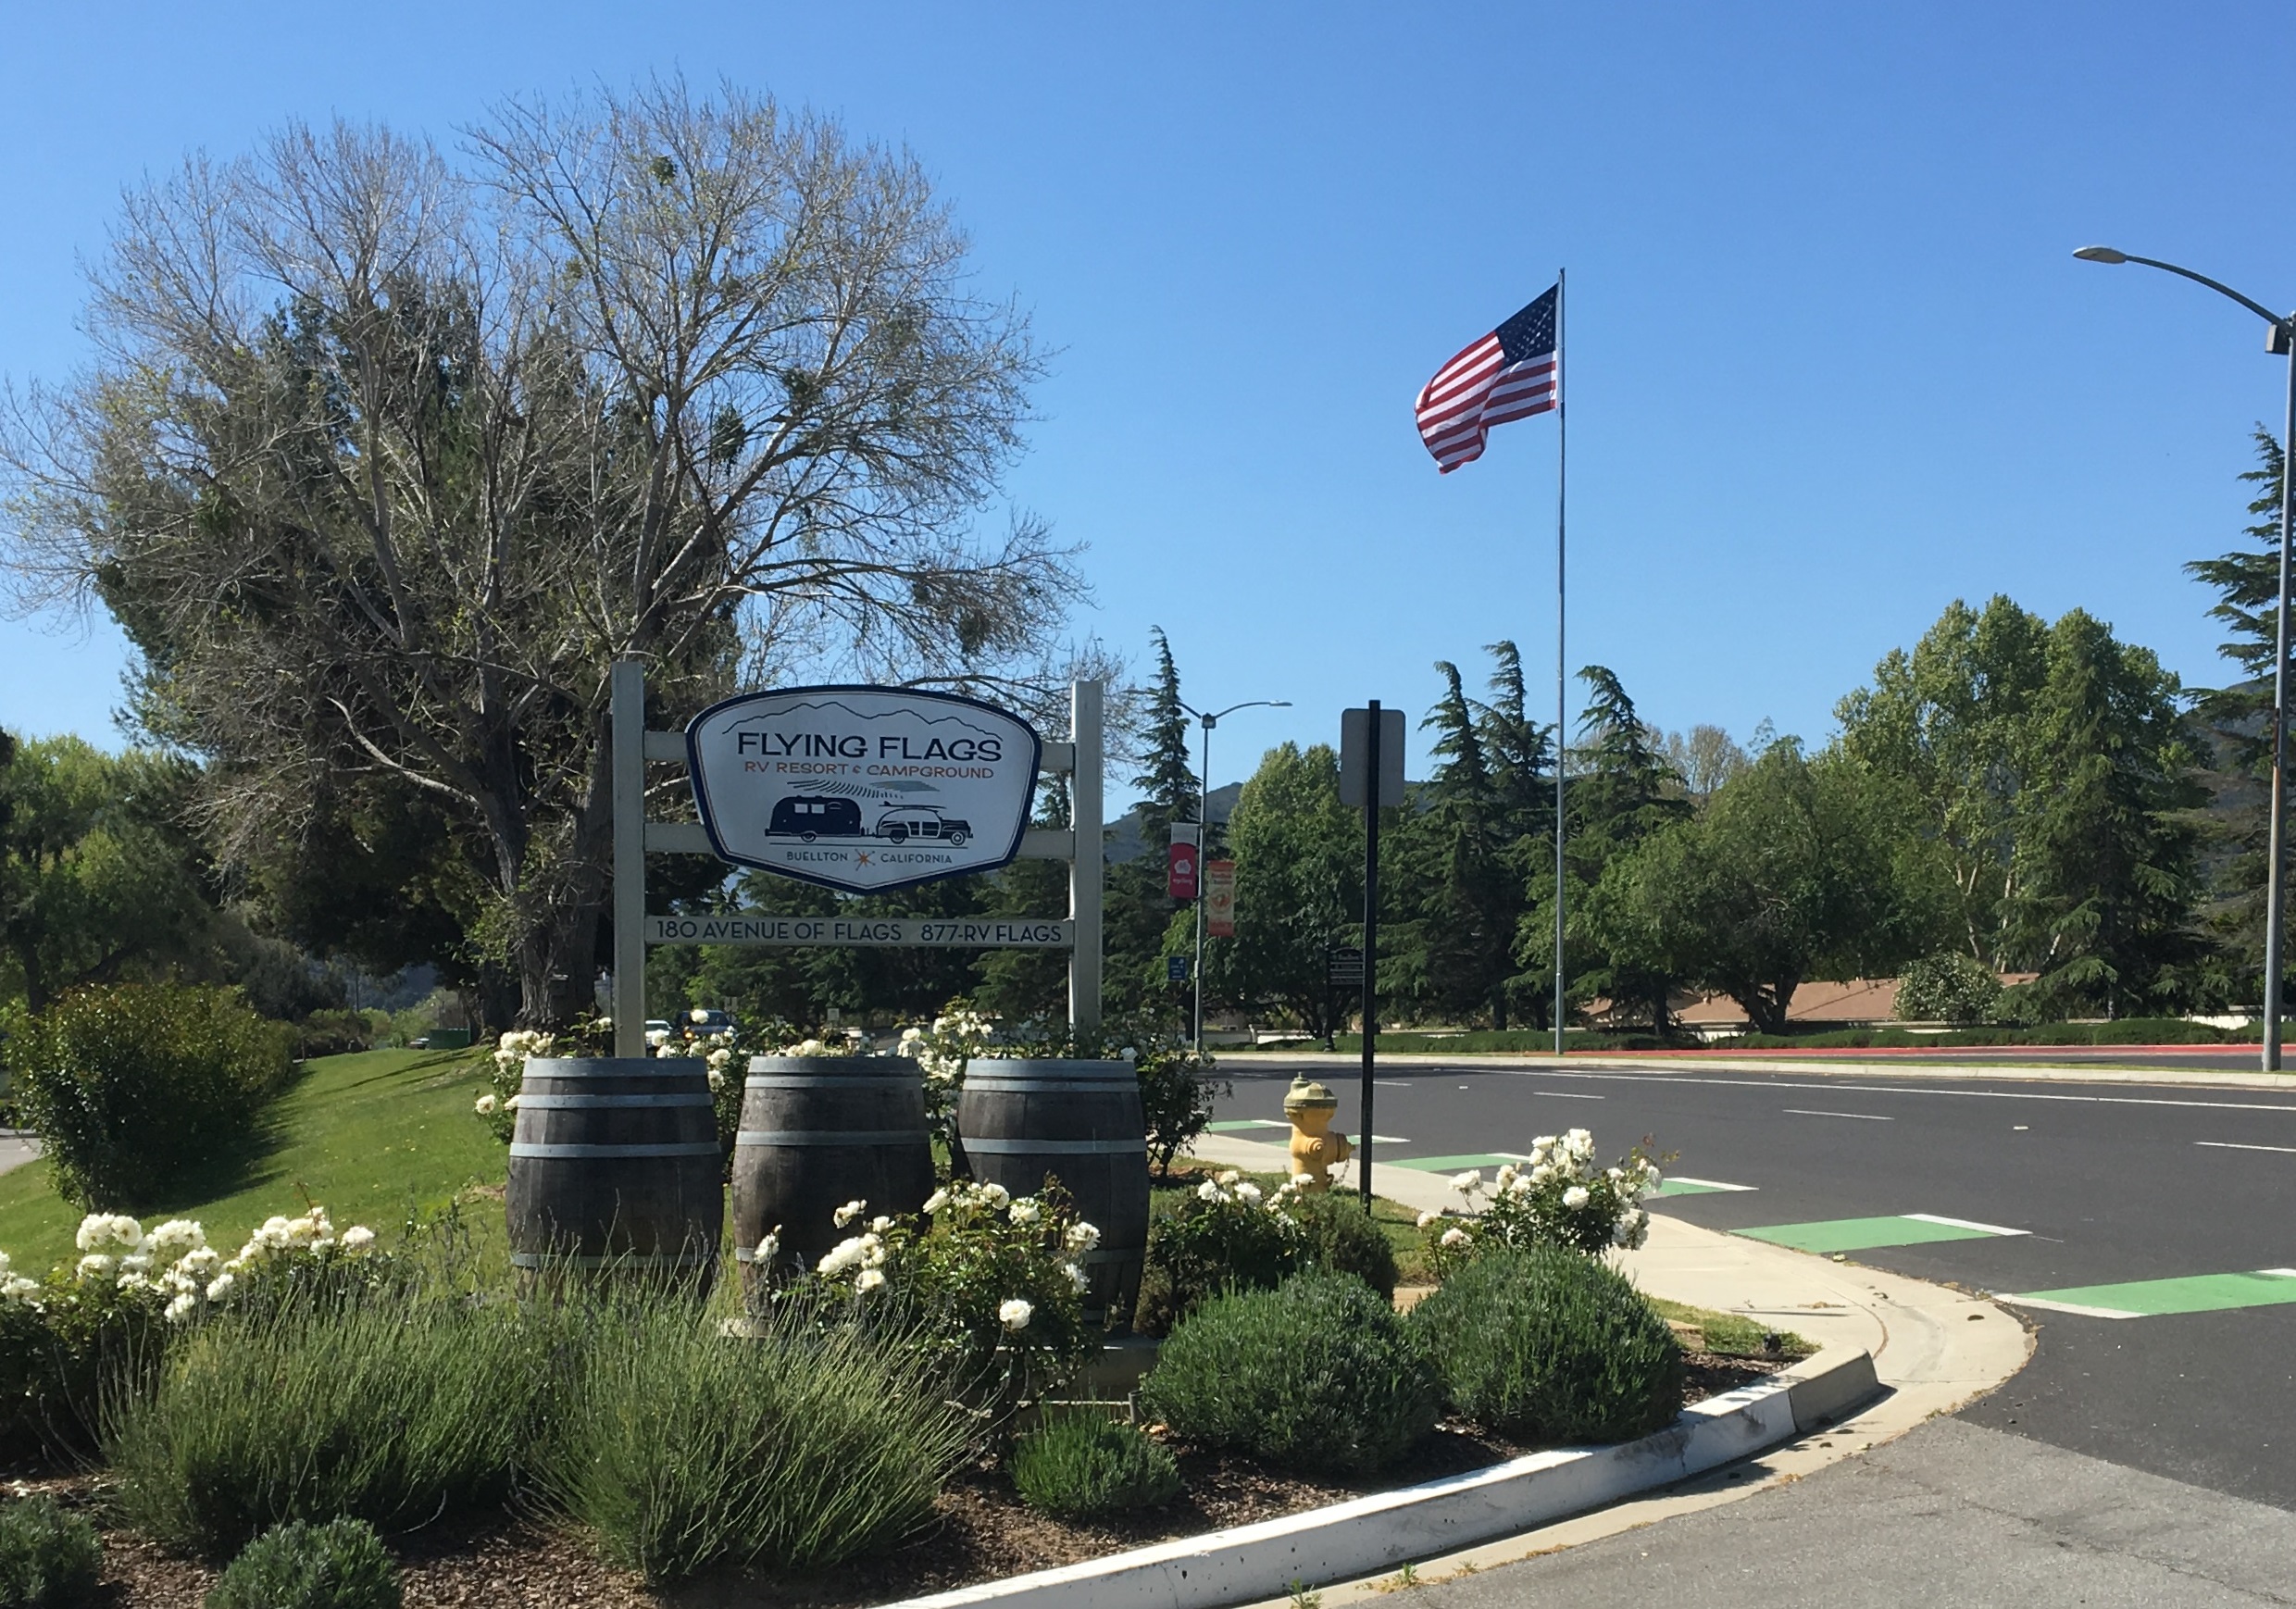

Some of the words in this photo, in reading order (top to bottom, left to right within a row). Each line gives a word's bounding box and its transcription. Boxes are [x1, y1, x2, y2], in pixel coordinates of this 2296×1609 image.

[738, 731, 868, 758] FLYING
[879, 736, 1003, 762] FLAGS
[744, 761, 769, 773] RV
[776, 762, 849, 775] RESORT
[852, 764, 861, 775] &
[867, 765, 994, 779] CAMPGROUND
[786, 851, 848, 862] BUELLTON
[880, 853, 953, 864] CALIFORNIA
[656, 920, 697, 939] 180
[702, 921, 789, 940] AVENUE
[794, 922, 824, 940] OF
[834, 923, 902, 941] FLAGS
[921, 924, 991, 942] 877-RV
[996, 925, 1062, 942] FLAGS
